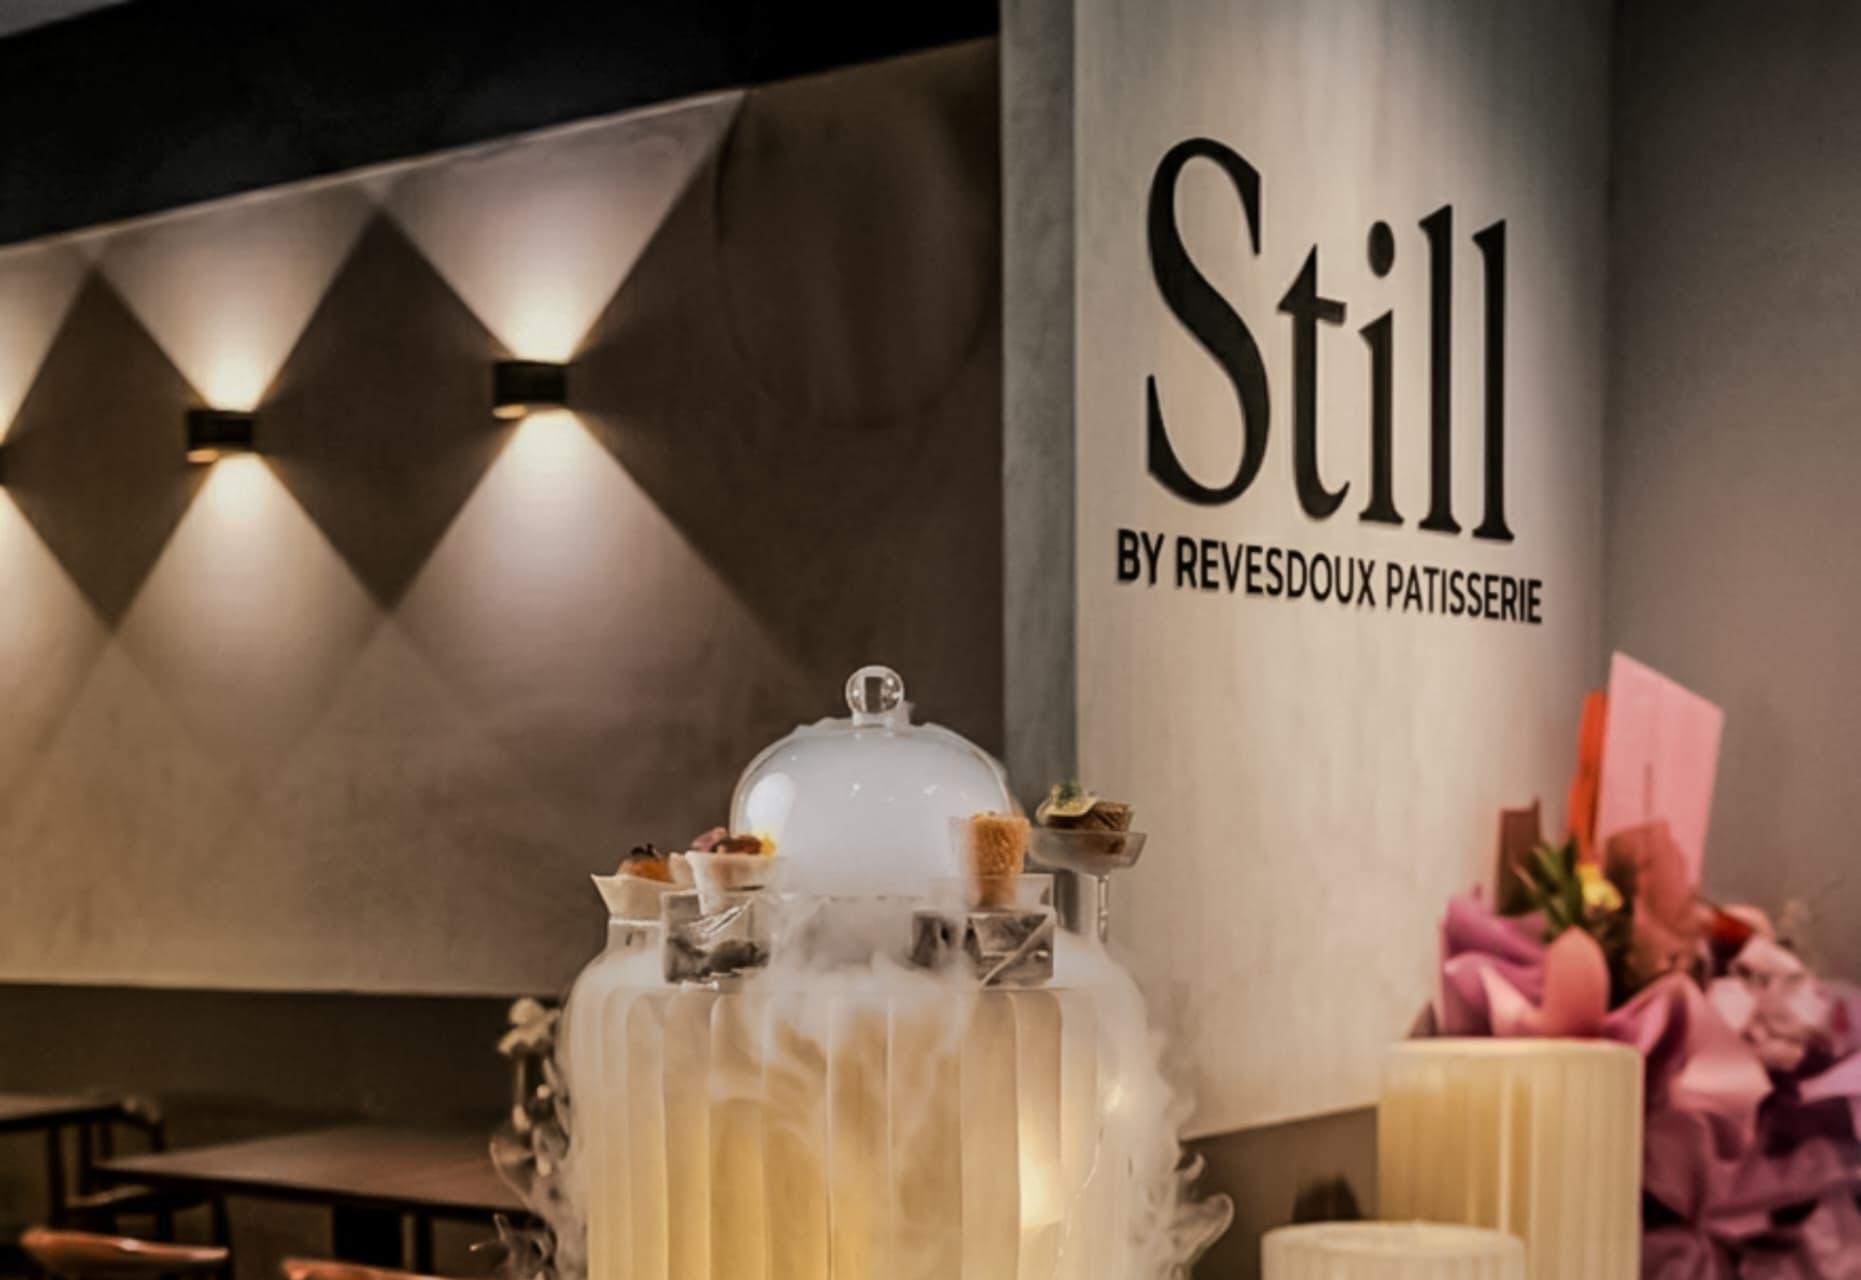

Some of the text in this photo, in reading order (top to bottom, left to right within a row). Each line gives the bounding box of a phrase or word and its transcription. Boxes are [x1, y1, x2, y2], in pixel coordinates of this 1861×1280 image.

[1146, 137, 1516, 543] Still
[1115, 528, 1543, 625] BY REVESDOUX PATISSERIE
